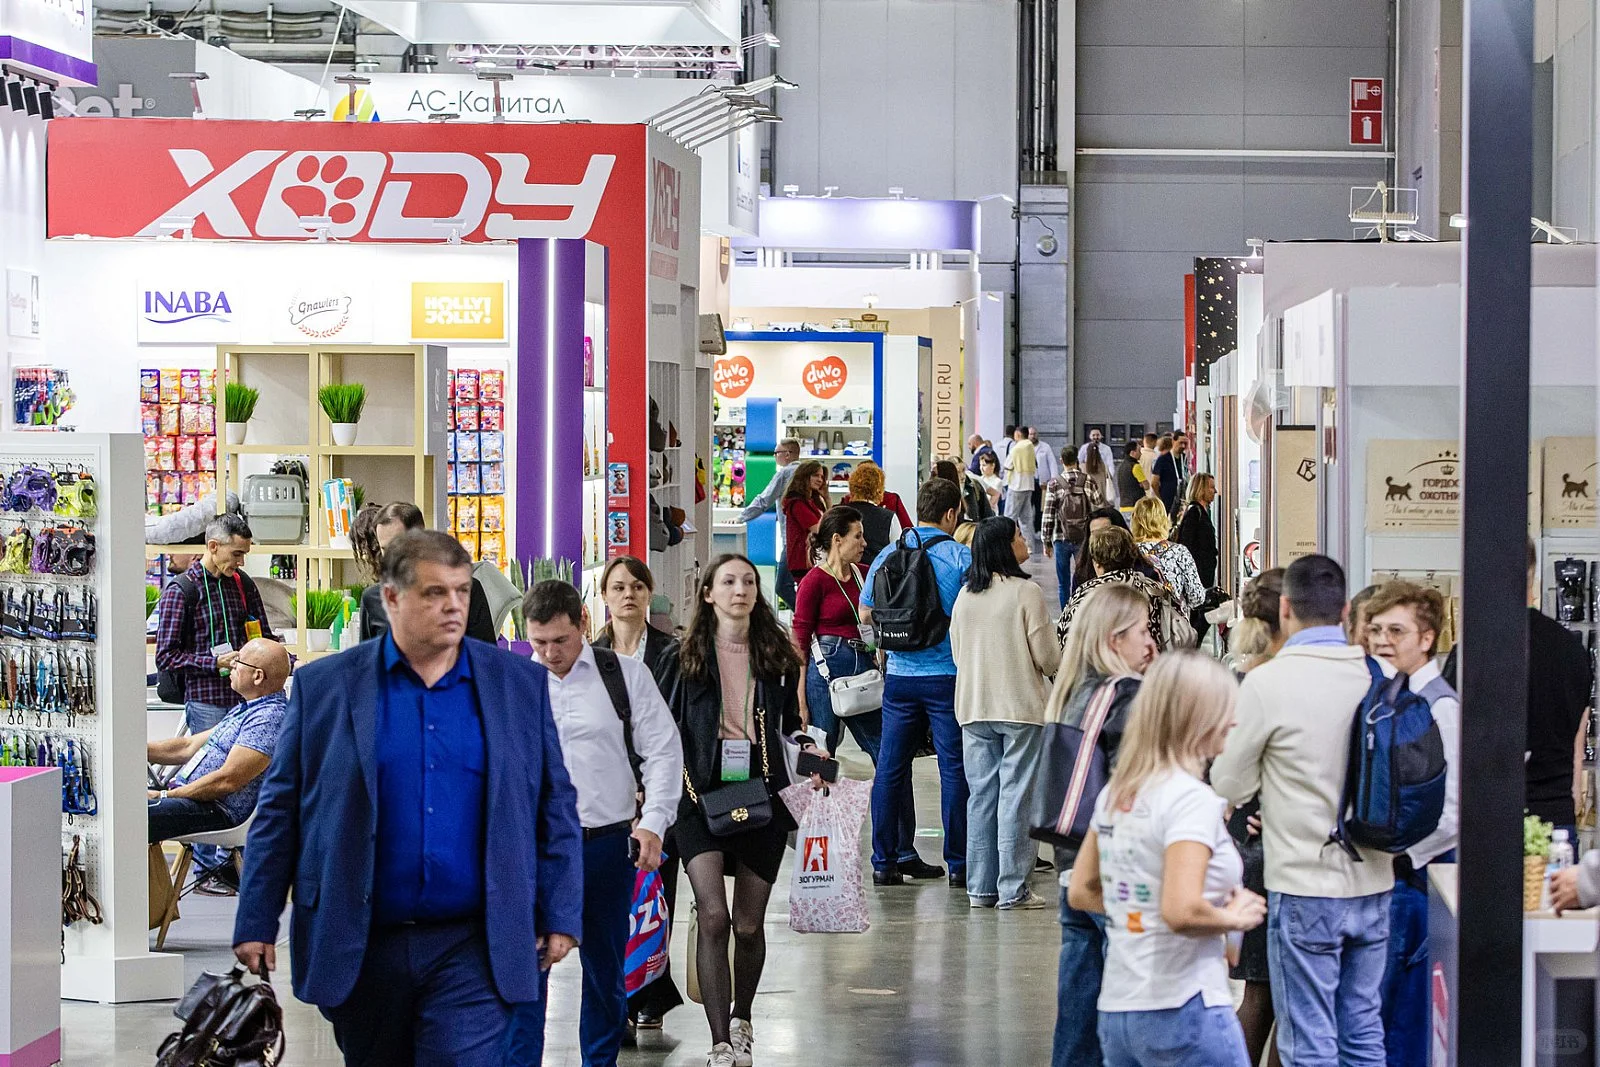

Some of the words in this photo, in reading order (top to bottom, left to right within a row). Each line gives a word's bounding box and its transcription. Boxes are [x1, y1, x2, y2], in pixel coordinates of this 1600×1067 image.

[407, 89, 566, 114] АС-Капитал
[144, 291, 232, 314] INABA
[298, 297, 339, 315] Gnawlers
[714, 363, 748, 382] duvo
[806, 364, 841, 383] duvo
[720, 379, 746, 394] plus
[813, 379, 839, 395] plus
